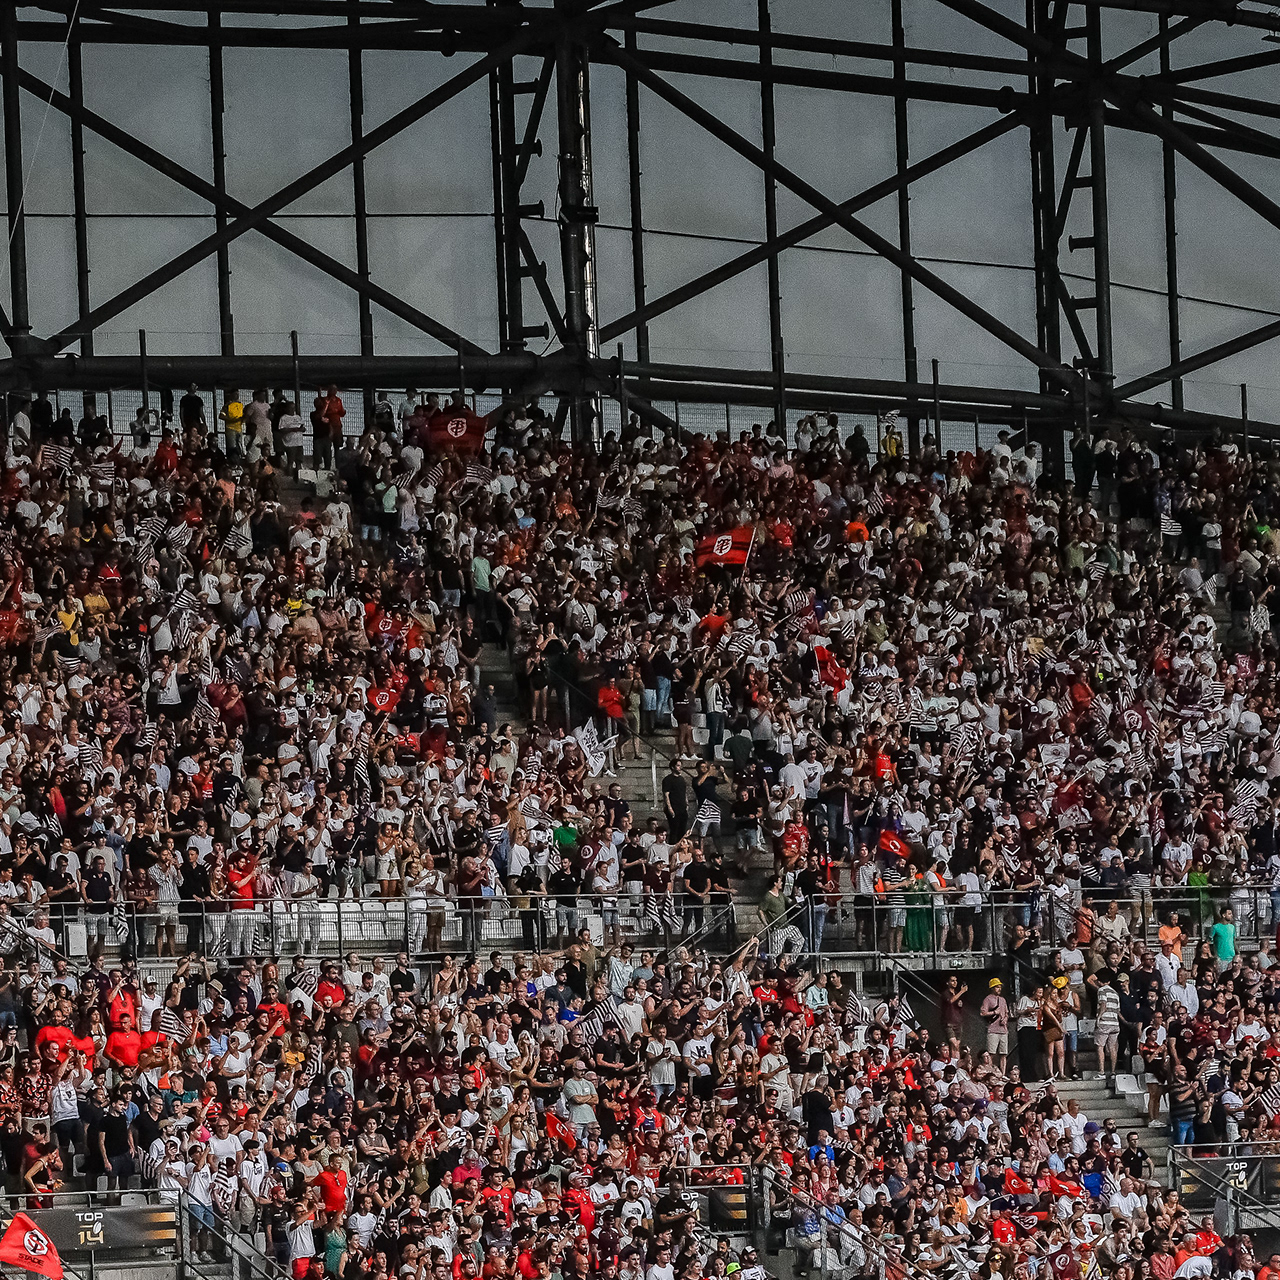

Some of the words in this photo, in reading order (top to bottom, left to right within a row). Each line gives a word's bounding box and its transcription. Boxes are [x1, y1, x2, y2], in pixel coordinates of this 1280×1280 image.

[1225, 1158, 1248, 1168] TOP
[74, 1211, 104, 1222] TOP
[77, 1230, 104, 1245] 14
[18, 1252, 45, 1266] STADE
